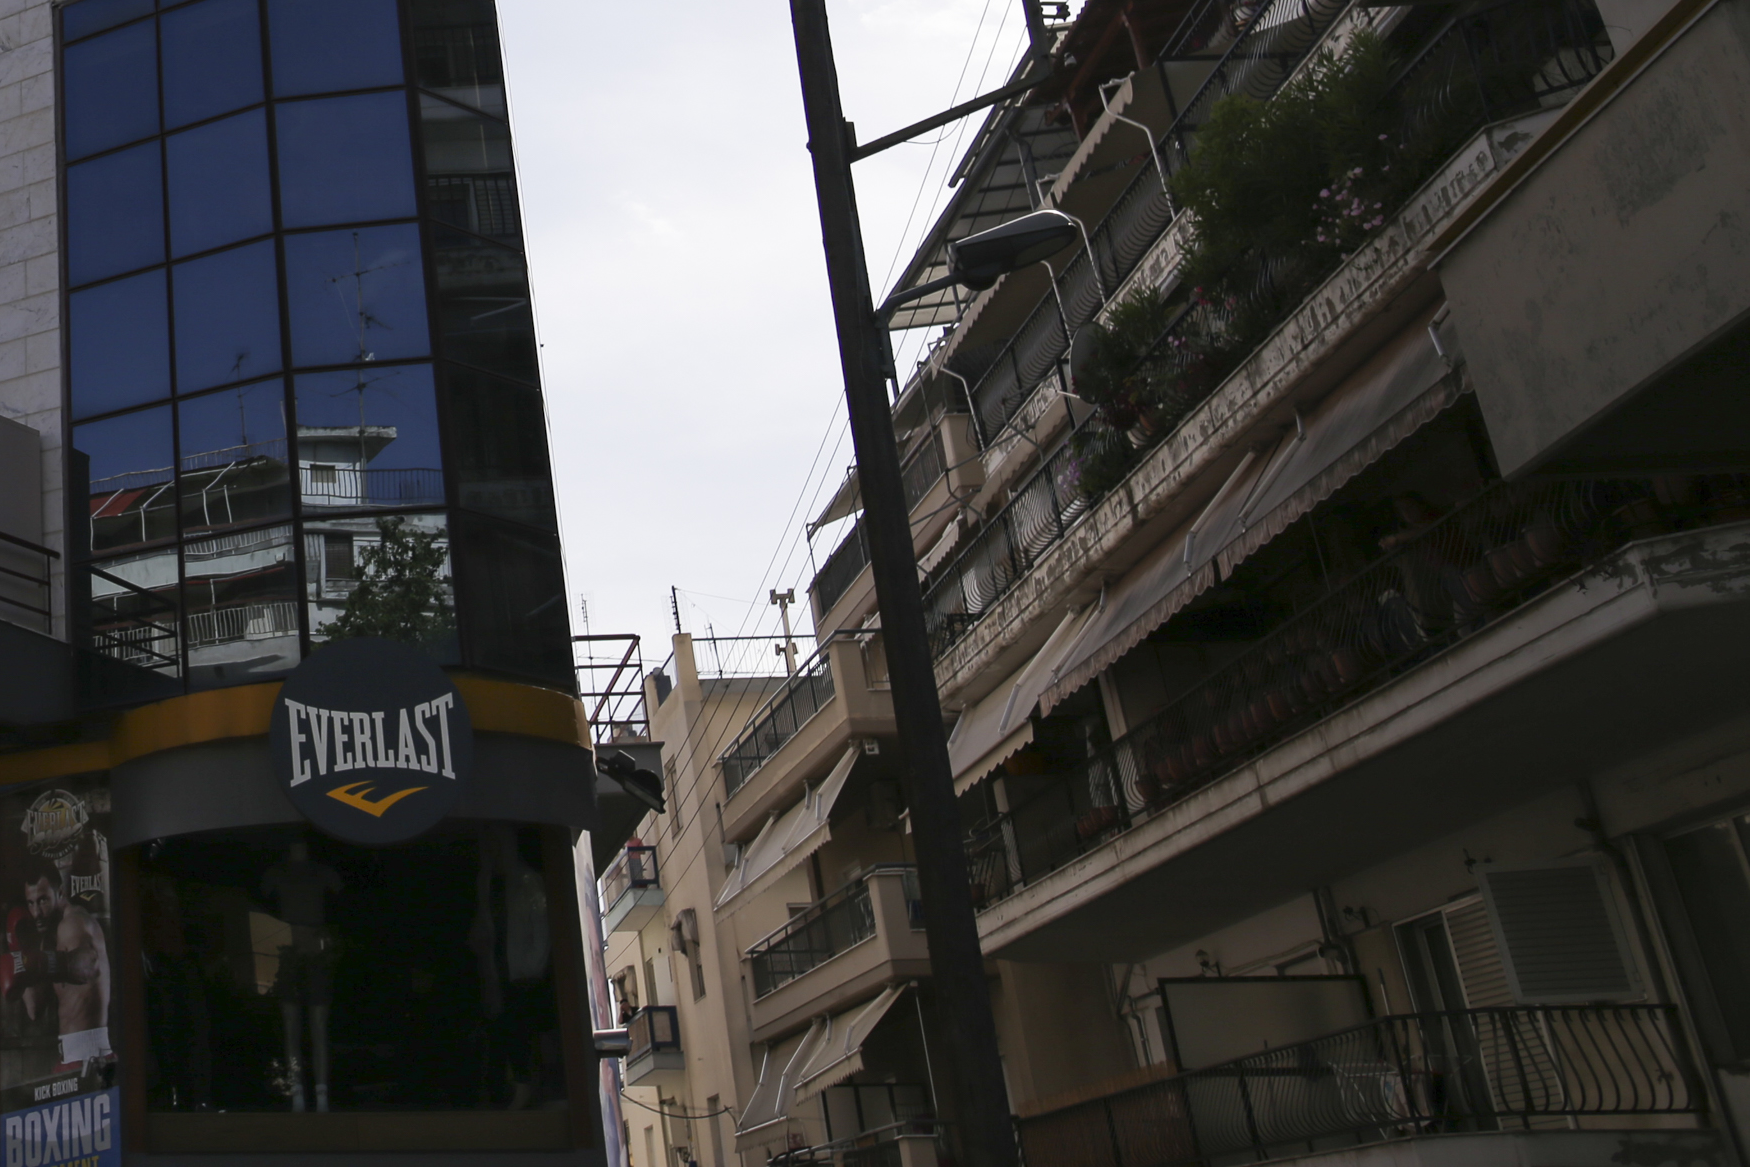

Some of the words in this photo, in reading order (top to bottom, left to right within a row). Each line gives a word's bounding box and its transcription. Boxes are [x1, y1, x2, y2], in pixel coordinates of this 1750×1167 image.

[284, 692, 456, 787] EVERLAST
[35, 1085, 50, 1101] KICK
[53, 1078, 78, 1096] BOXING
[5, 1093, 112, 1167] BOXING
